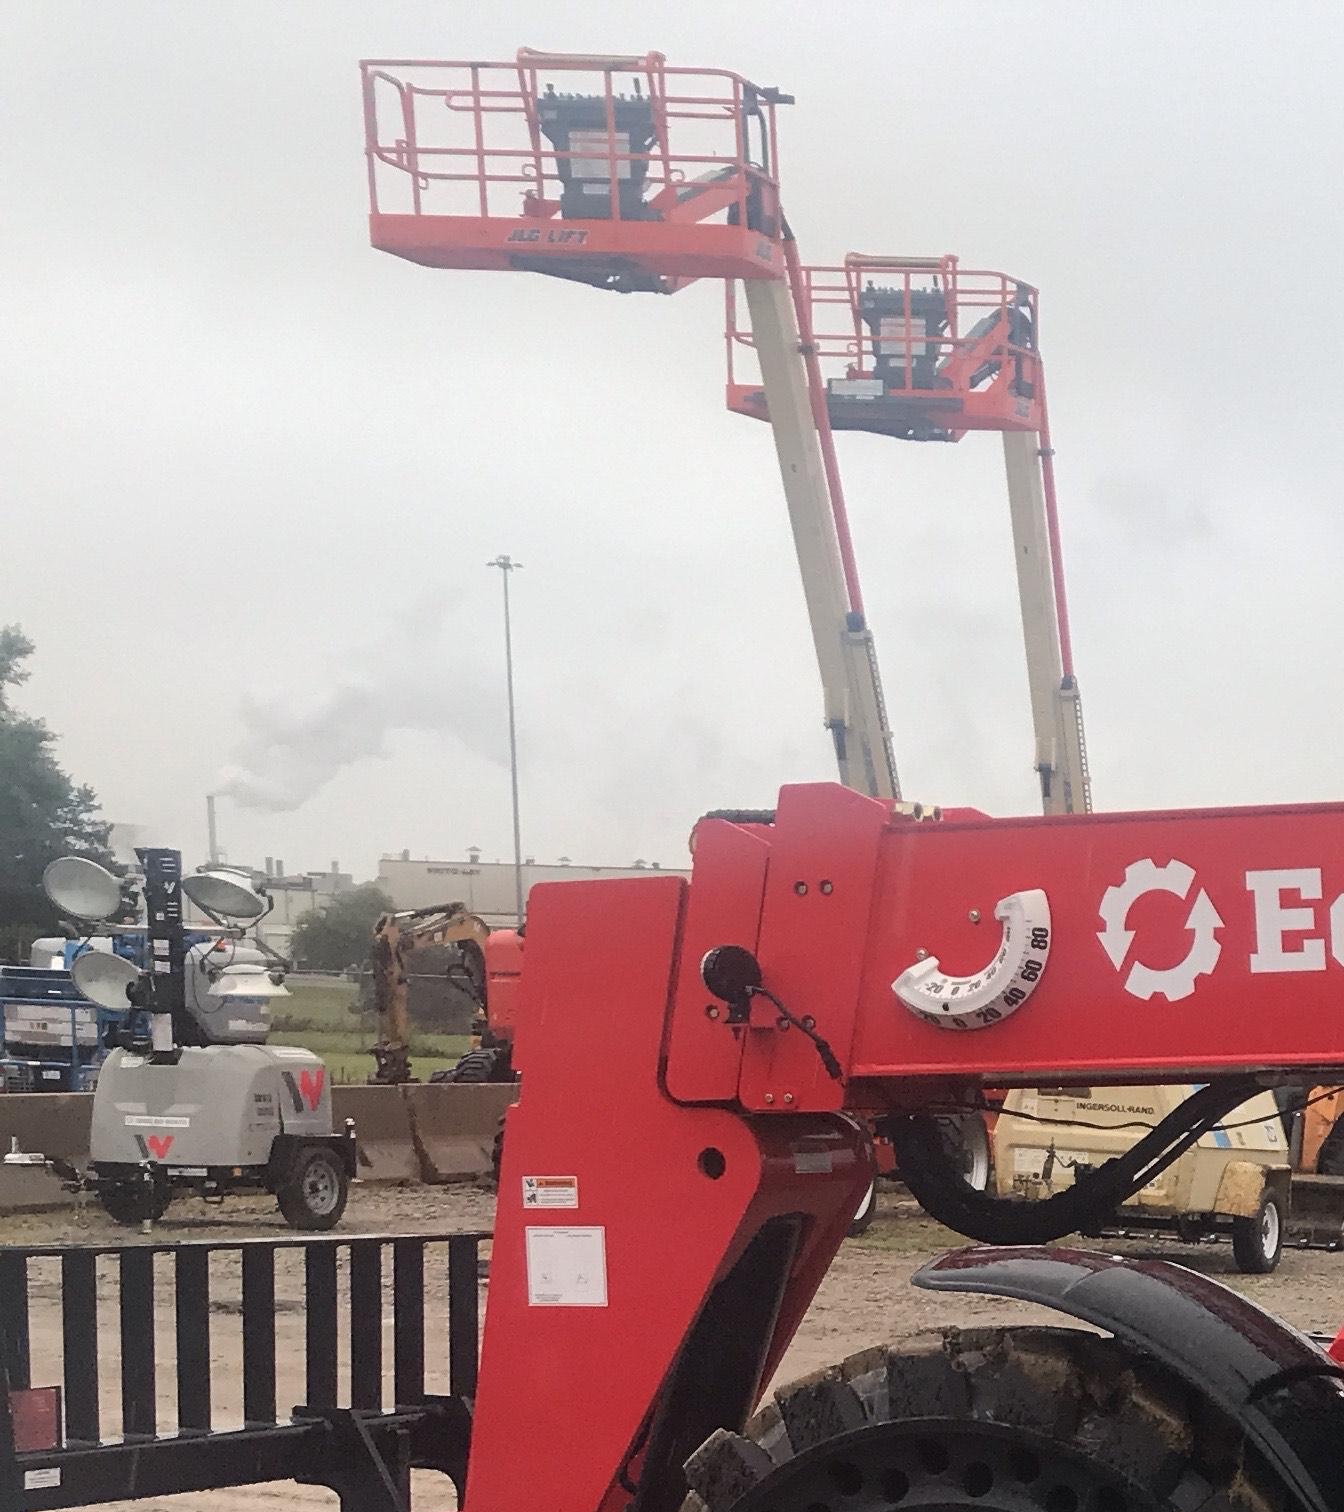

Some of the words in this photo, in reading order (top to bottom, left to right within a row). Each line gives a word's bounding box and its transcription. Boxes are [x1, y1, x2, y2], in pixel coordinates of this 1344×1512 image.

[1031, 927, 1048, 950] 80
[1021, 959, 1042, 983] 60
[1003, 987, 1026, 1007] 40
[976, 1007, 1002, 1024] 20
